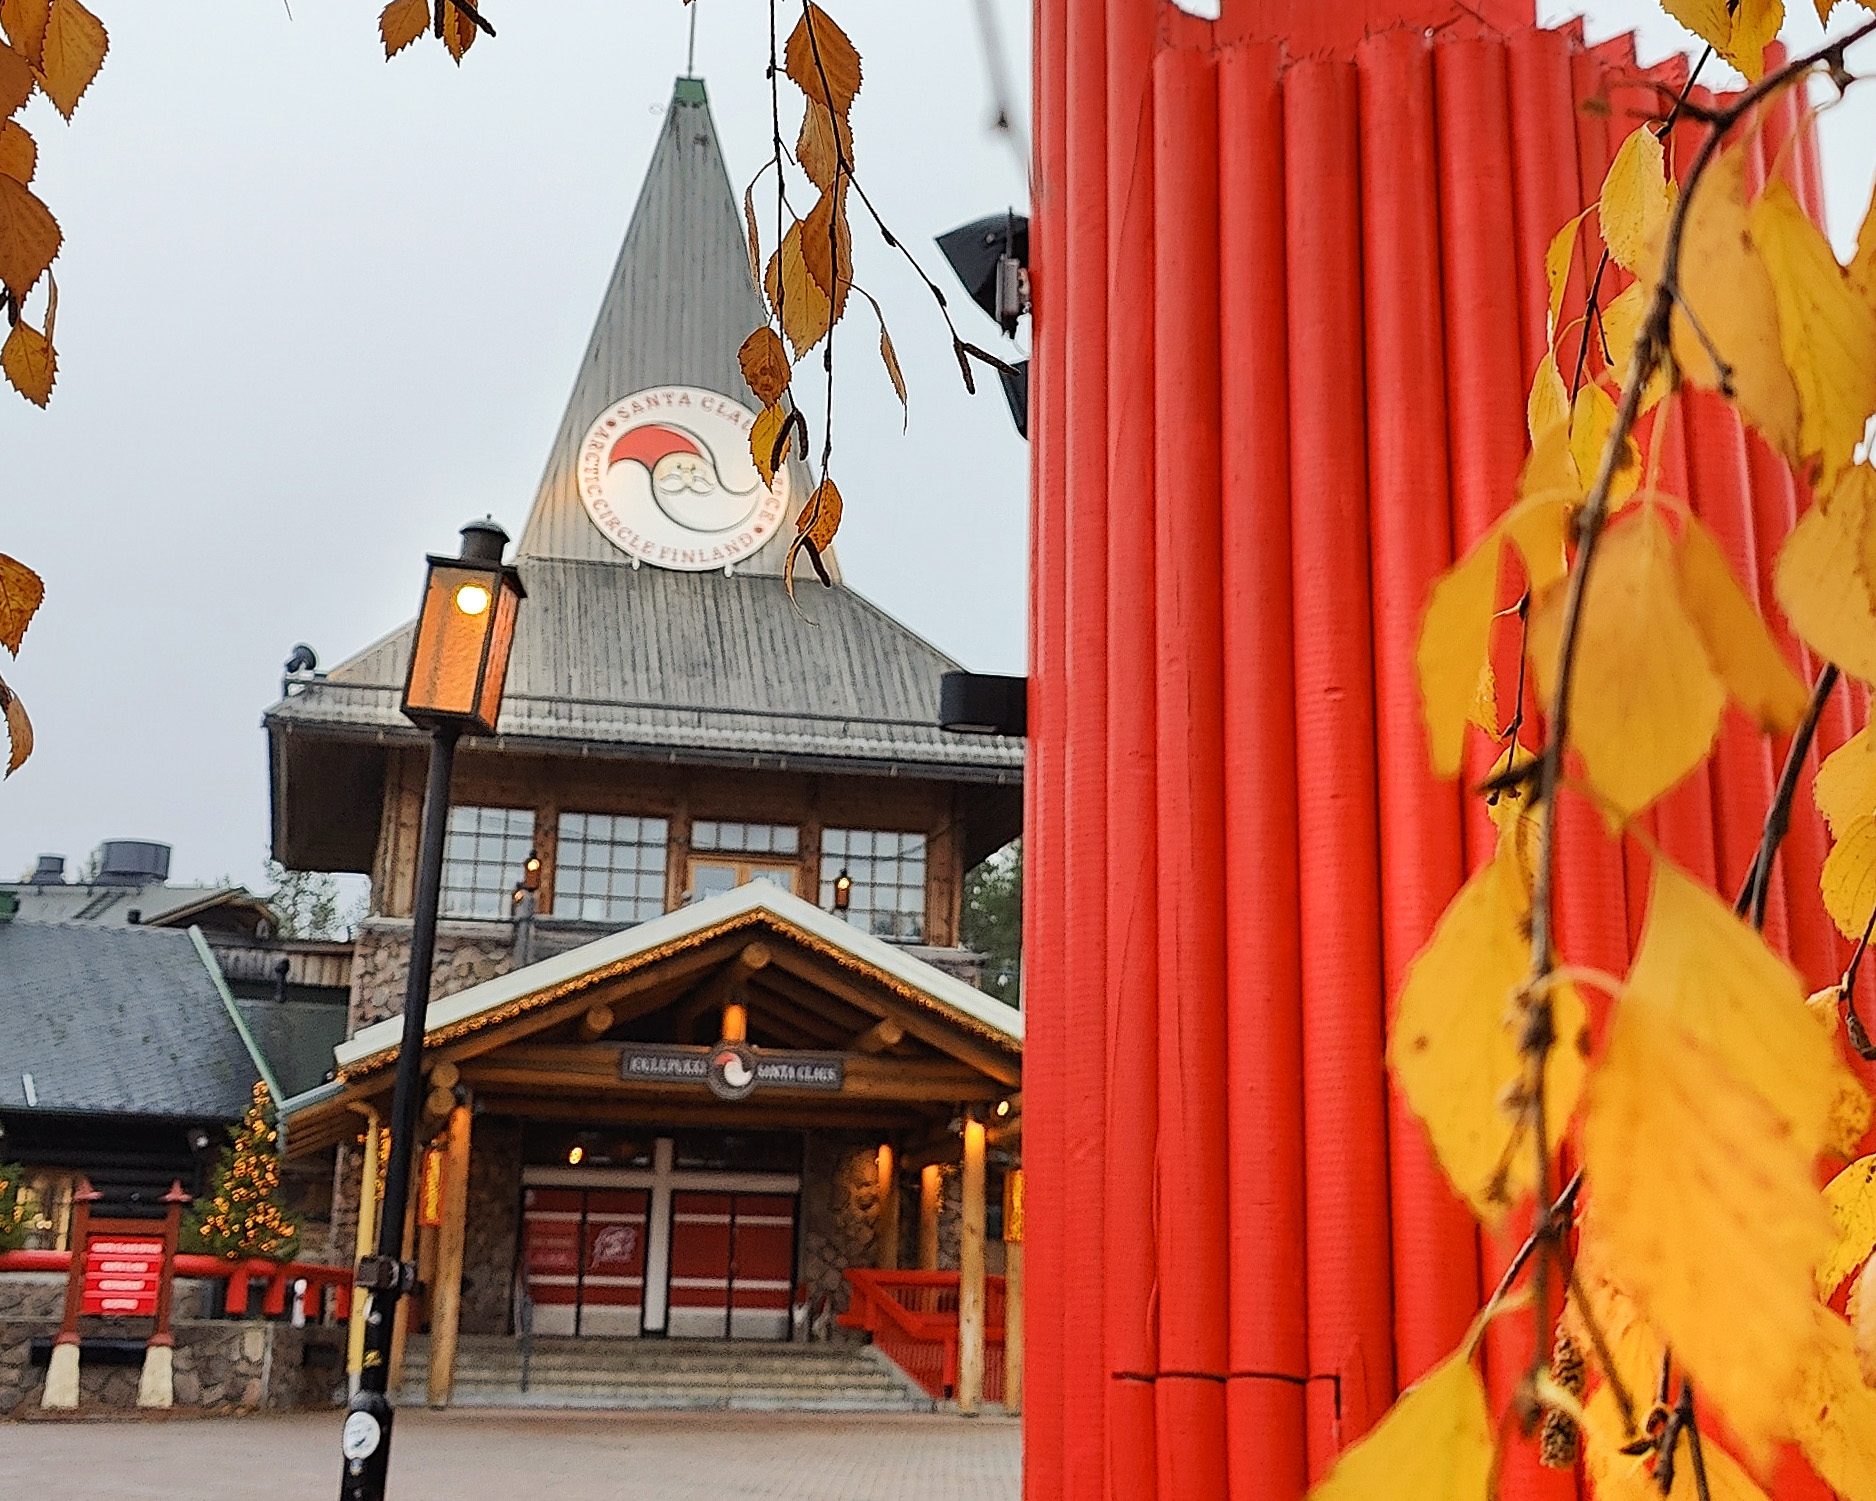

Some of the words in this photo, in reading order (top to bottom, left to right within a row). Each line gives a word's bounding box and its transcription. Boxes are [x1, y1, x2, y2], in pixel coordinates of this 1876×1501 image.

[618, 392, 691, 421] SANTA
[701, 396, 752, 432] CLA
[584, 427, 609, 497] ARCTIC
[593, 499, 655, 555] CIRCLE
[658, 533, 753, 563] FINLAND
